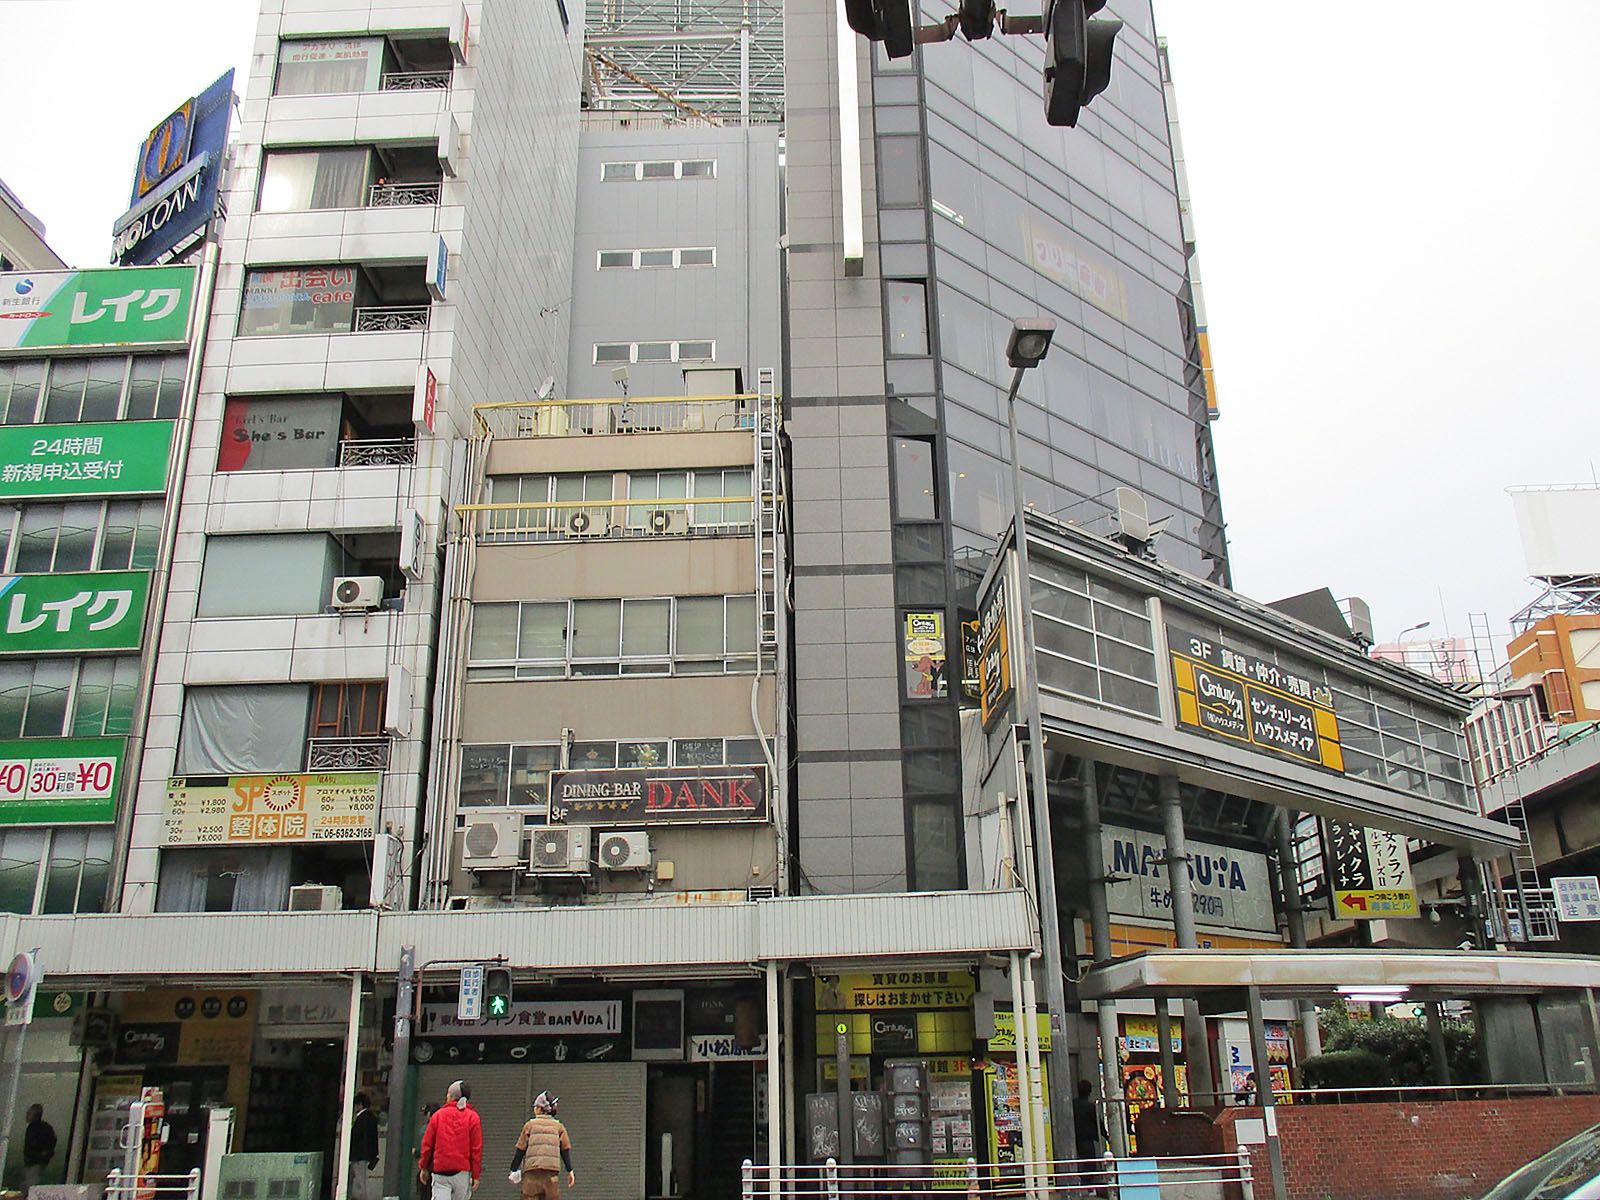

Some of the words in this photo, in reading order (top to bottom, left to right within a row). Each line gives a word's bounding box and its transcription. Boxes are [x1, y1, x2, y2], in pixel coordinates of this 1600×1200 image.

[279, 269, 352, 289] 出会い
[70, 288, 182, 324] レイク
[311, 290, 353, 304] cafe
[293, 428, 325, 440] Bar
[32, 437, 104, 456] 24時間
[1, 460, 124, 482] 新規申込受付
[6, 590, 133, 634] レイク
[1189, 638, 1211, 659] 3F
[1252, 697, 1313, 732] センチュリー21
[1254, 720, 1314, 752] ハウスメディア
[76, 762, 113, 792] ¥0
[562, 783, 612, 798] DINING
[614, 782, 642, 796] BAR
[645, 778, 755, 809] DANK
[551, 808, 569, 821] 3F
[230, 815, 306, 838] 整体院
